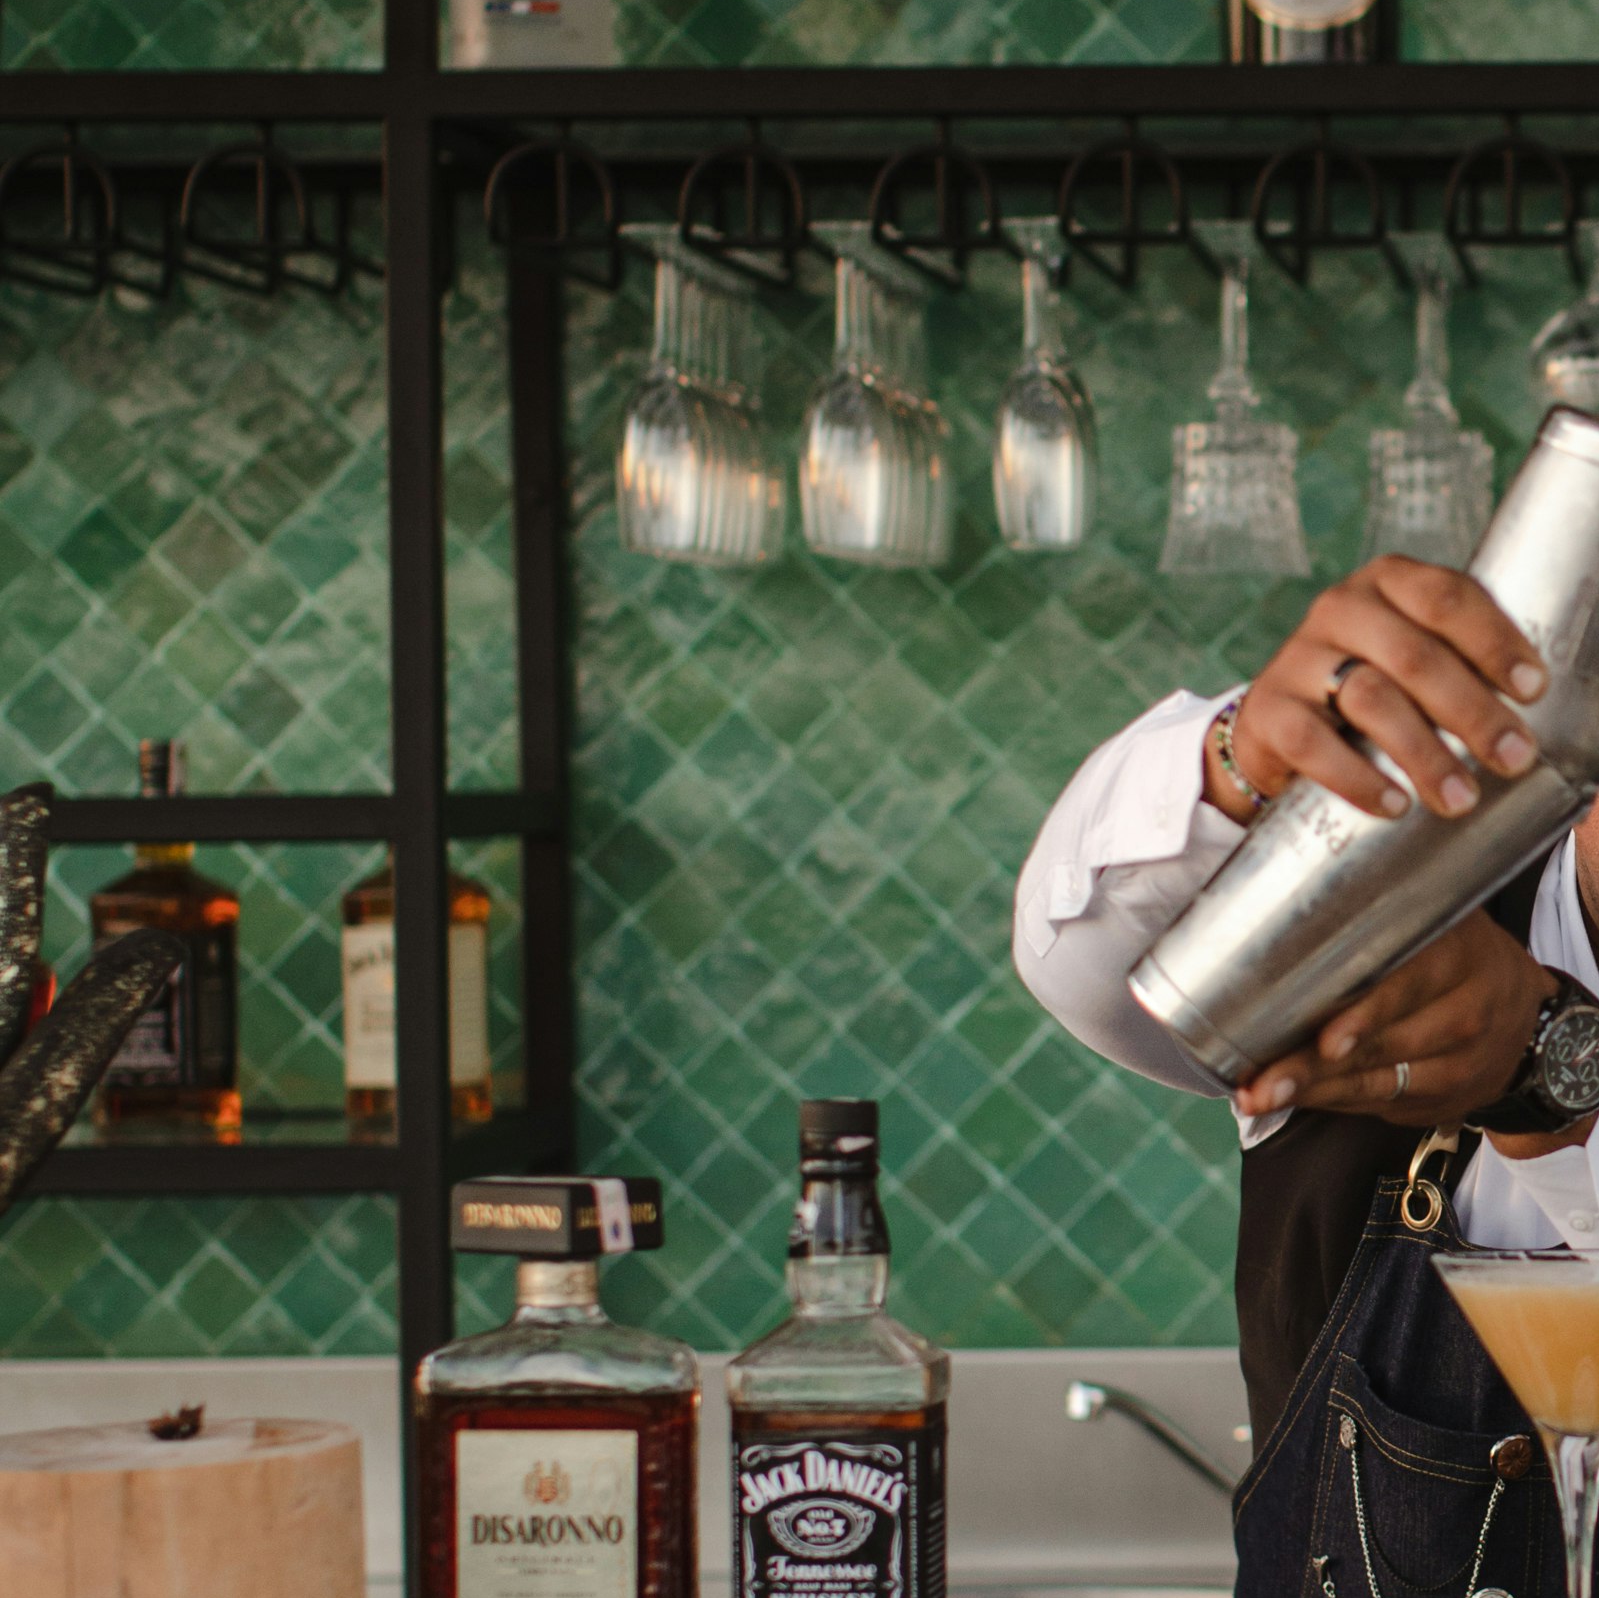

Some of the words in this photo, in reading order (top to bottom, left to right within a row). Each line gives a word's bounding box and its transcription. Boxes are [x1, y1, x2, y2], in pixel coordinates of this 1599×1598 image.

[462, 1202, 562, 1230] DISARONNO
[740, 1461, 806, 1514] JACK
[803, 1450, 909, 1514] DANIEL'S
[471, 1514, 625, 1547] DISARONNO
[766, 1555, 878, 1581] Tennessee
